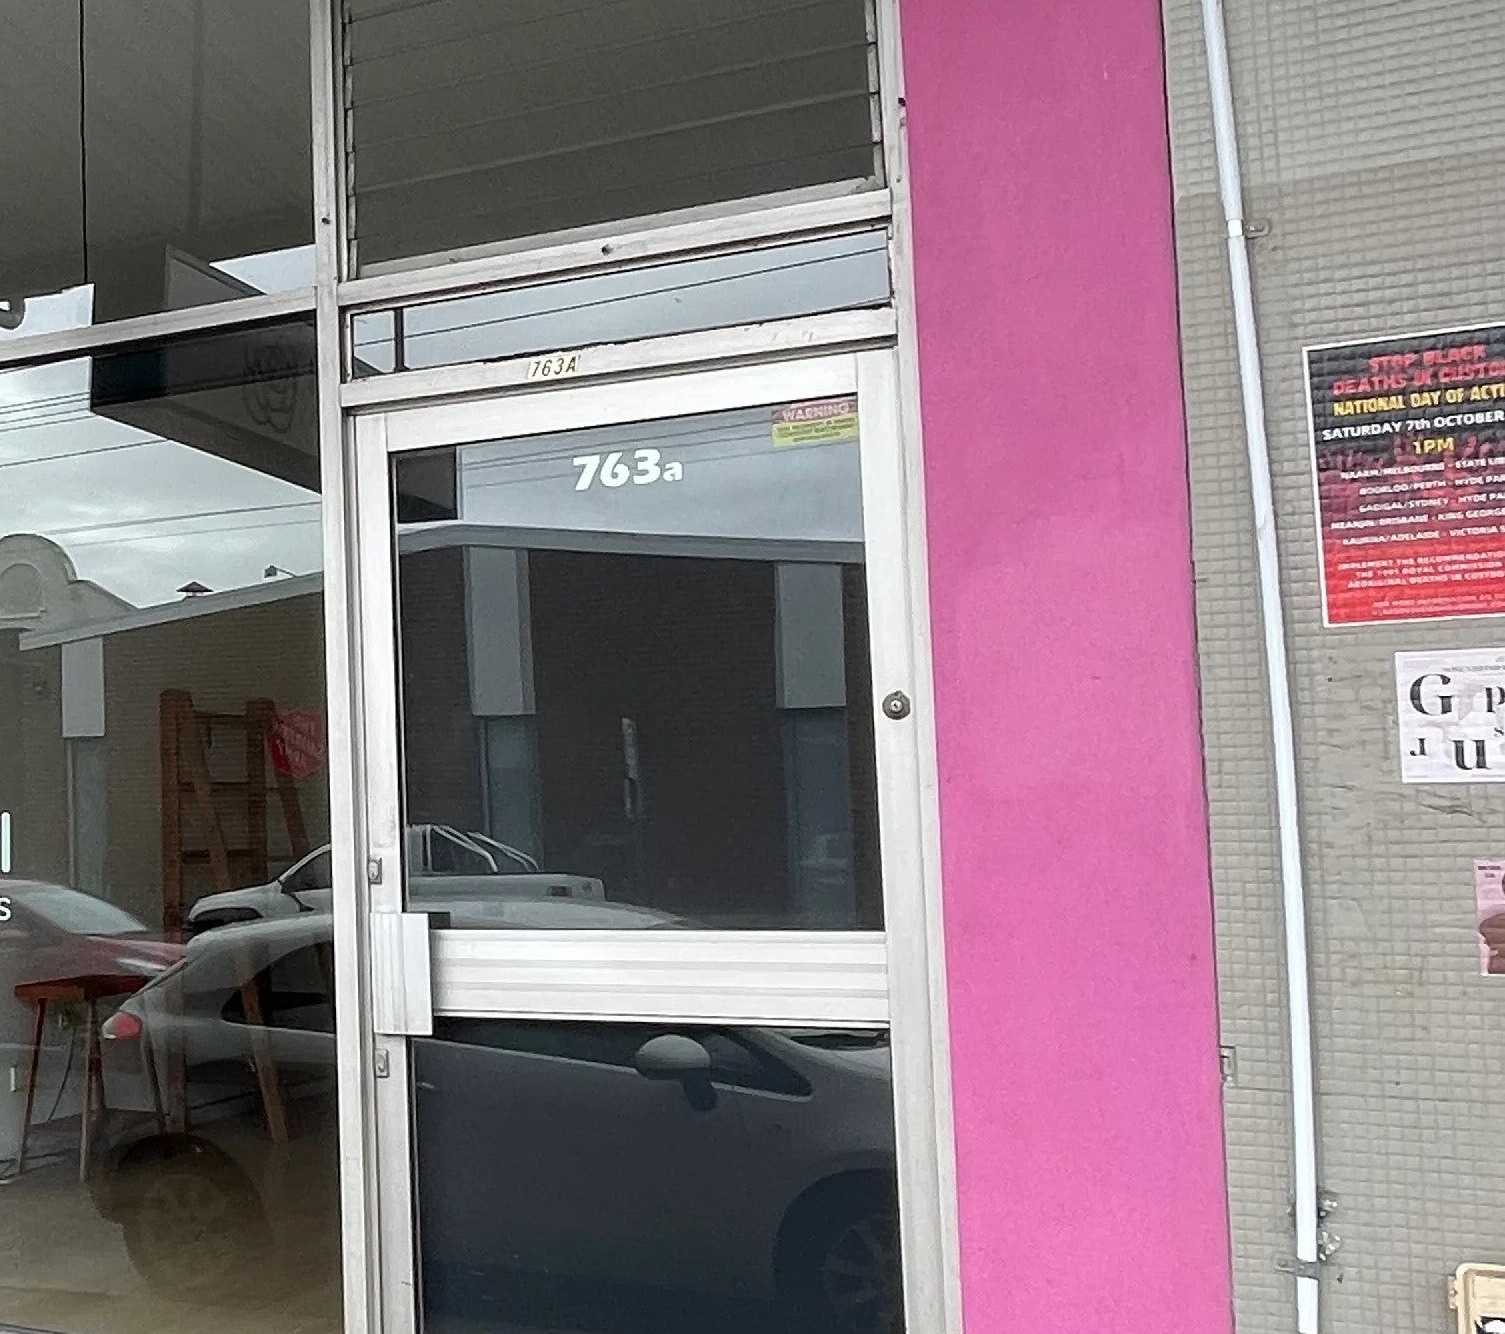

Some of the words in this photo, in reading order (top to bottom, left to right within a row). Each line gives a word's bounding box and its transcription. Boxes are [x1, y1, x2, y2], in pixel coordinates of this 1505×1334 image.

[530, 356, 578, 378] 763A
[1368, 353, 1416, 373] STOP
[1422, 344, 1488, 366] BLACK
[1332, 373, 1408, 397] DEATHS
[781, 402, 850, 422] WARNING
[1332, 394, 1407, 417] NATIONAL
[1409, 390, 1442, 410] DAY
[1445, 387, 1465, 404] OF
[1321, 420, 1404, 442] SATURDAY
[1406, 418, 1432, 432] 7th
[1433, 409, 1505, 428] OCTOBER
[1412, 436, 1456, 455] 1PM
[572, 448, 685, 493] 763a
